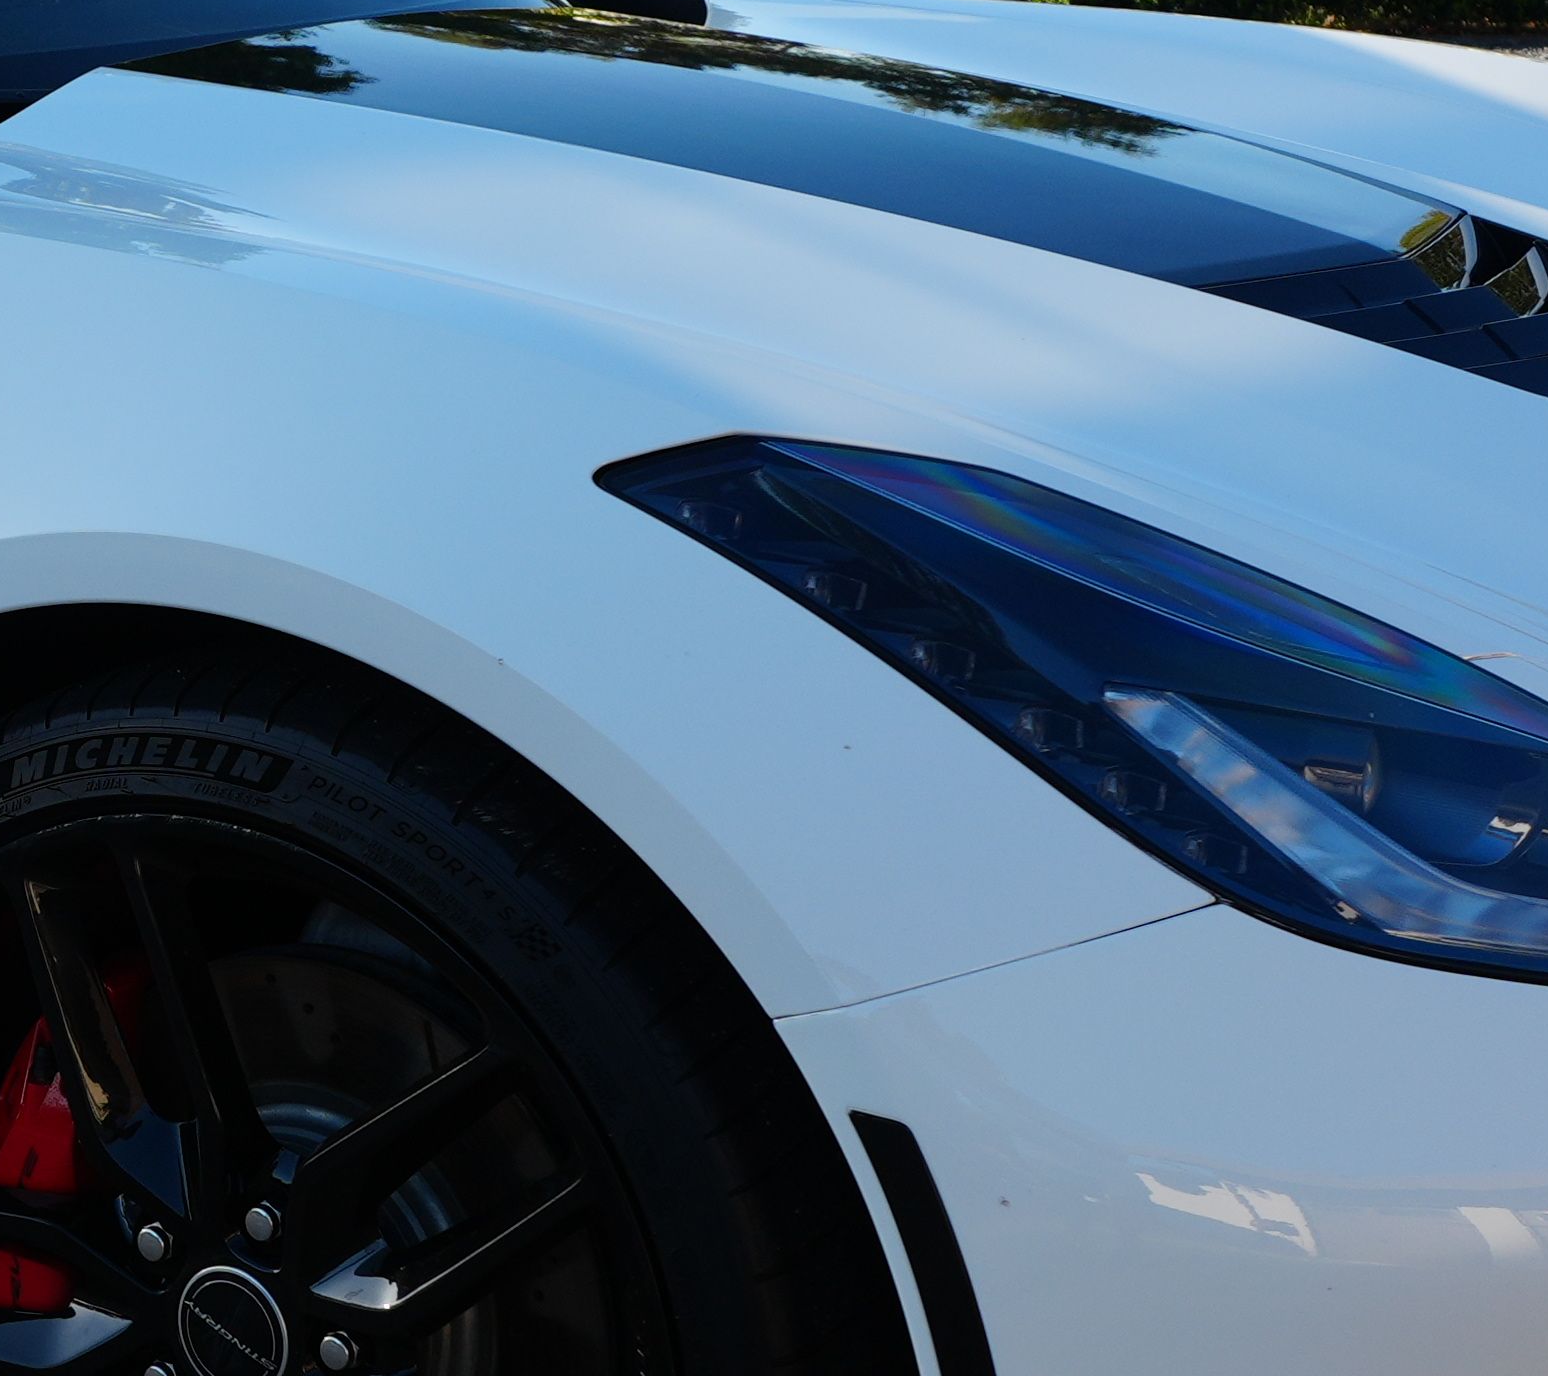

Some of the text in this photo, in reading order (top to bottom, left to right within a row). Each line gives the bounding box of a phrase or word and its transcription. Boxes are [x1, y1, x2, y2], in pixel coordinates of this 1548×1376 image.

[10, 736, 274, 789] MICHELIN
[84, 776, 129, 793] RADIAL
[306, 775, 388, 823] PILOT
[390, 821, 485, 889] SPORT
[480, 886, 498, 902] 4
[183, 1300, 279, 1371] STINGRAY
